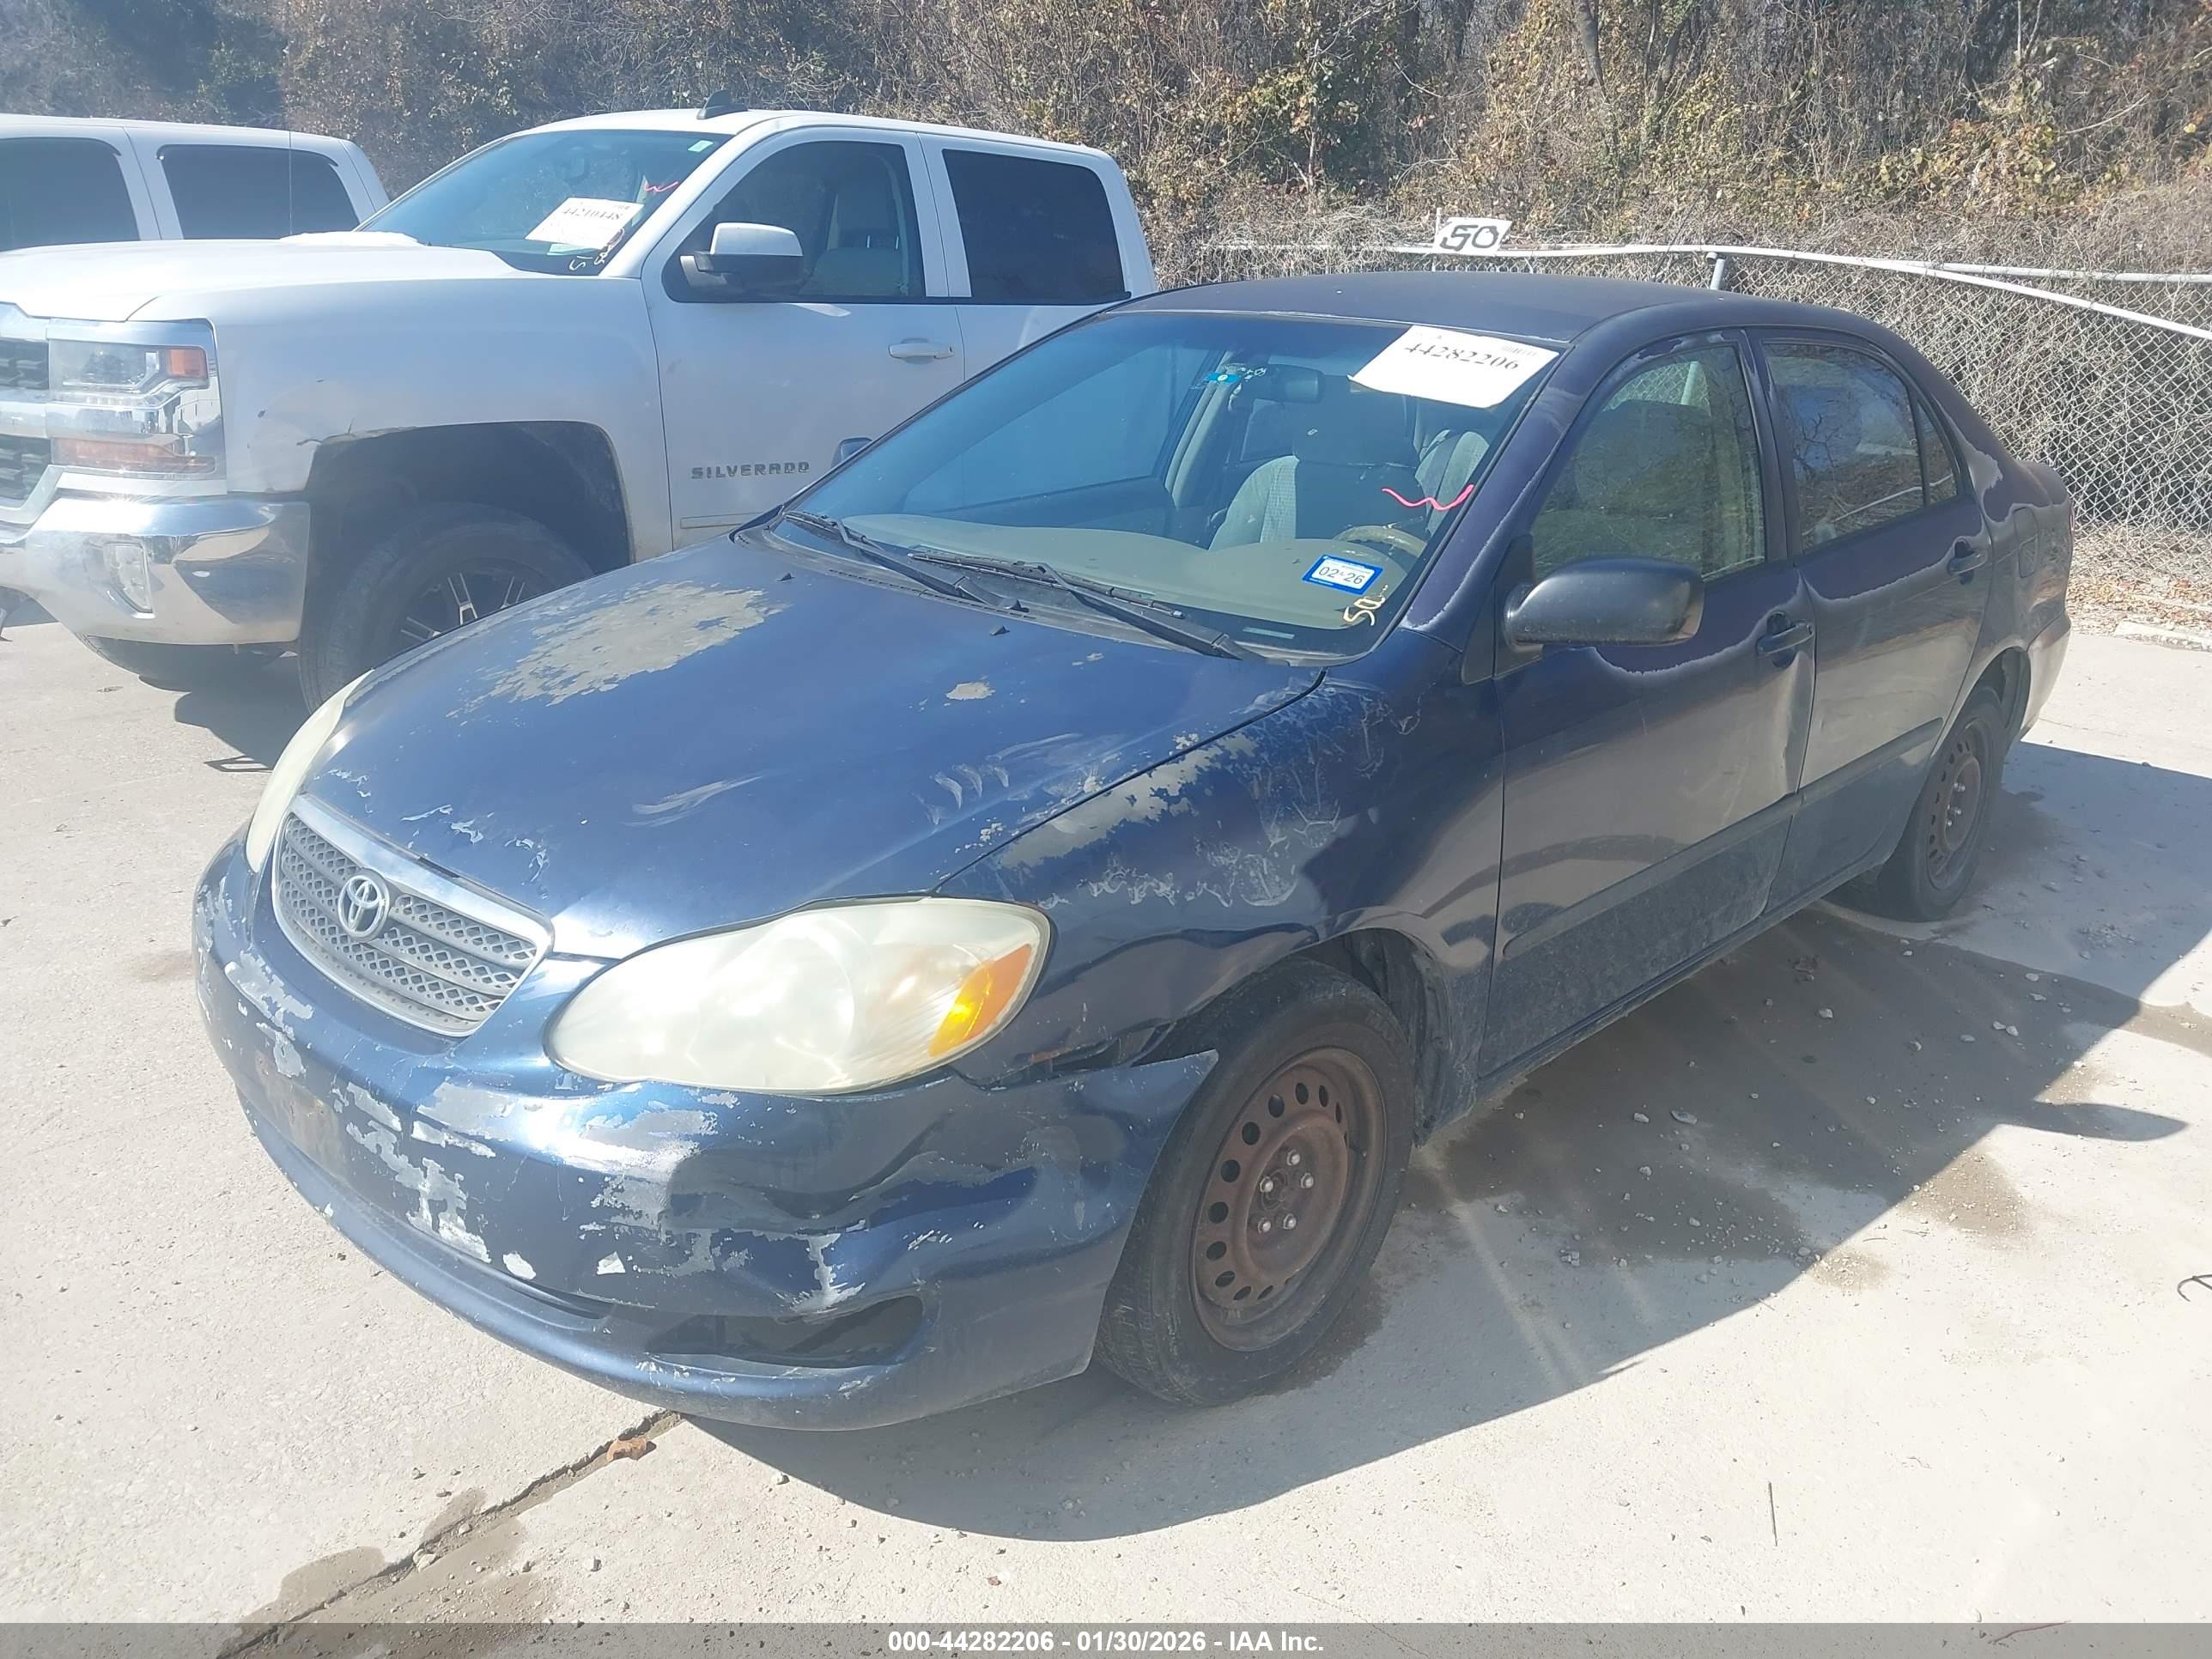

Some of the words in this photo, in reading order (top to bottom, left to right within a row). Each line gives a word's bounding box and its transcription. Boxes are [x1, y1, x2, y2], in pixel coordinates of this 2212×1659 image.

[1439, 224, 1499, 252] 50
[1404, 343, 1519, 371] 44282206
[691, 461, 811, 479] SILVERADO
